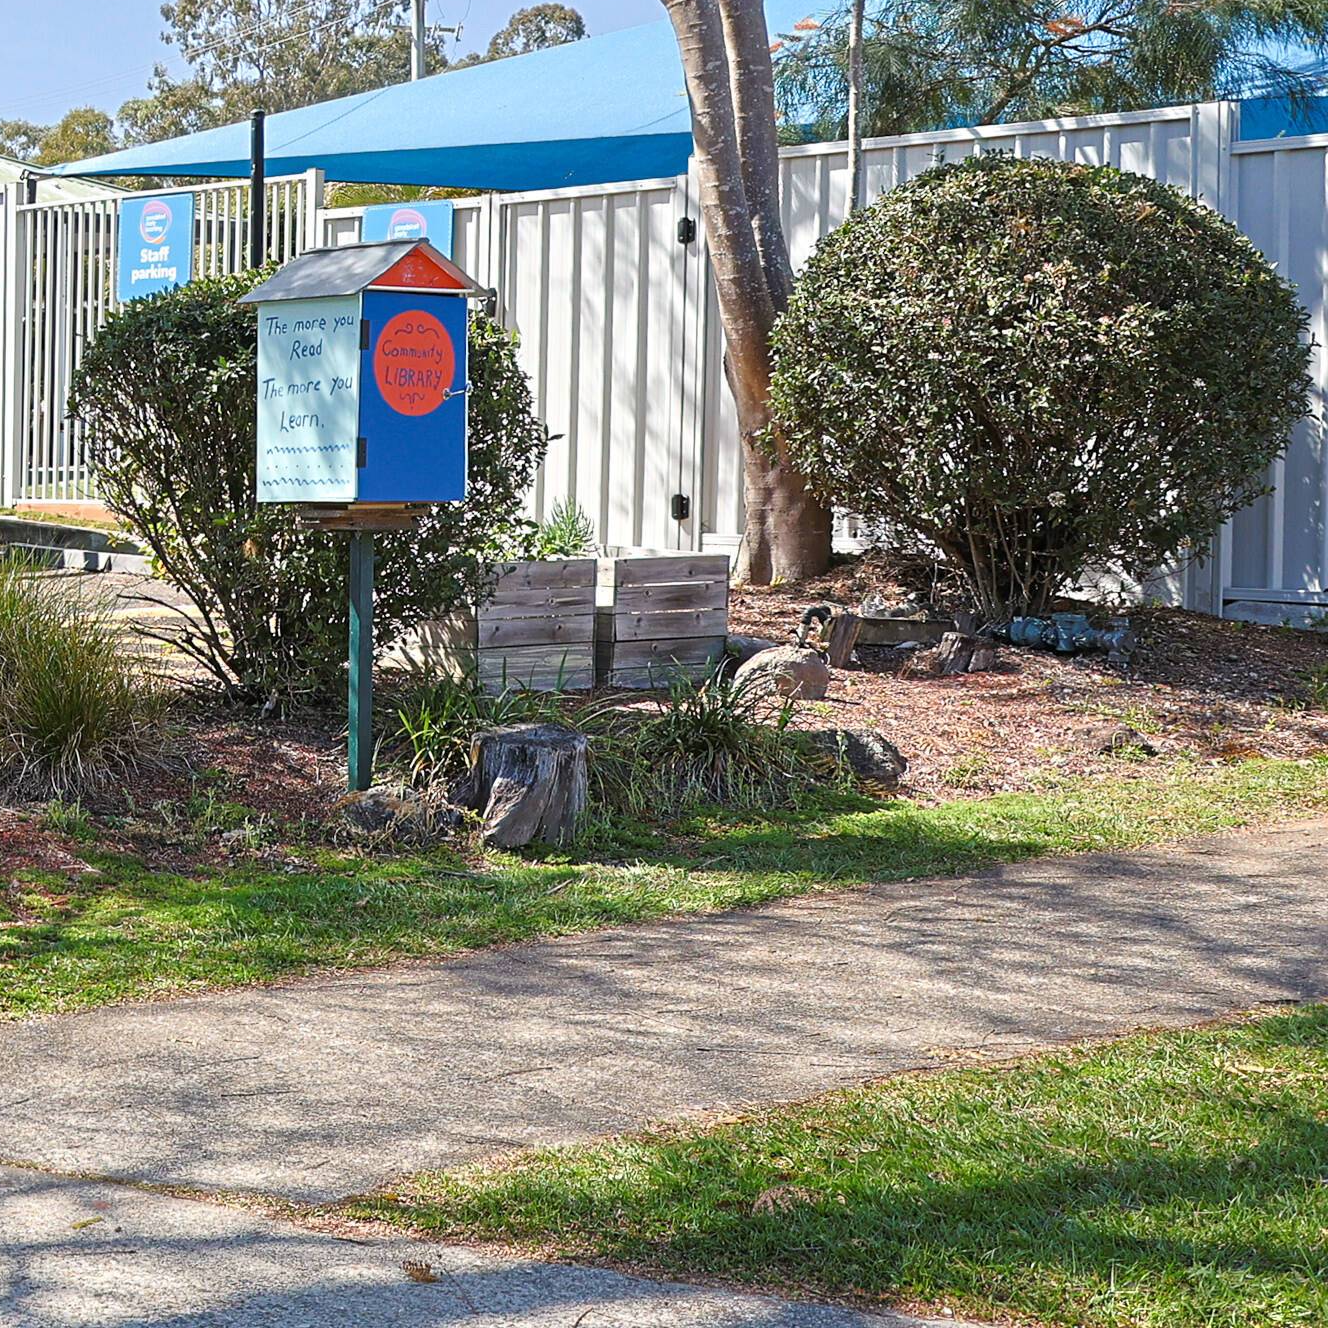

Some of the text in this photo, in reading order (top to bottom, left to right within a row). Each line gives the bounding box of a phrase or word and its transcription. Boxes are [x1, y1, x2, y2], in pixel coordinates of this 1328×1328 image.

[140, 245, 170, 263] Staff
[131, 263, 177, 285] parking
[266, 315, 354, 336] The more you
[290, 338, 323, 361] Read
[262, 376, 353, 400] The more you
[384, 365, 443, 390] LIBRARY
